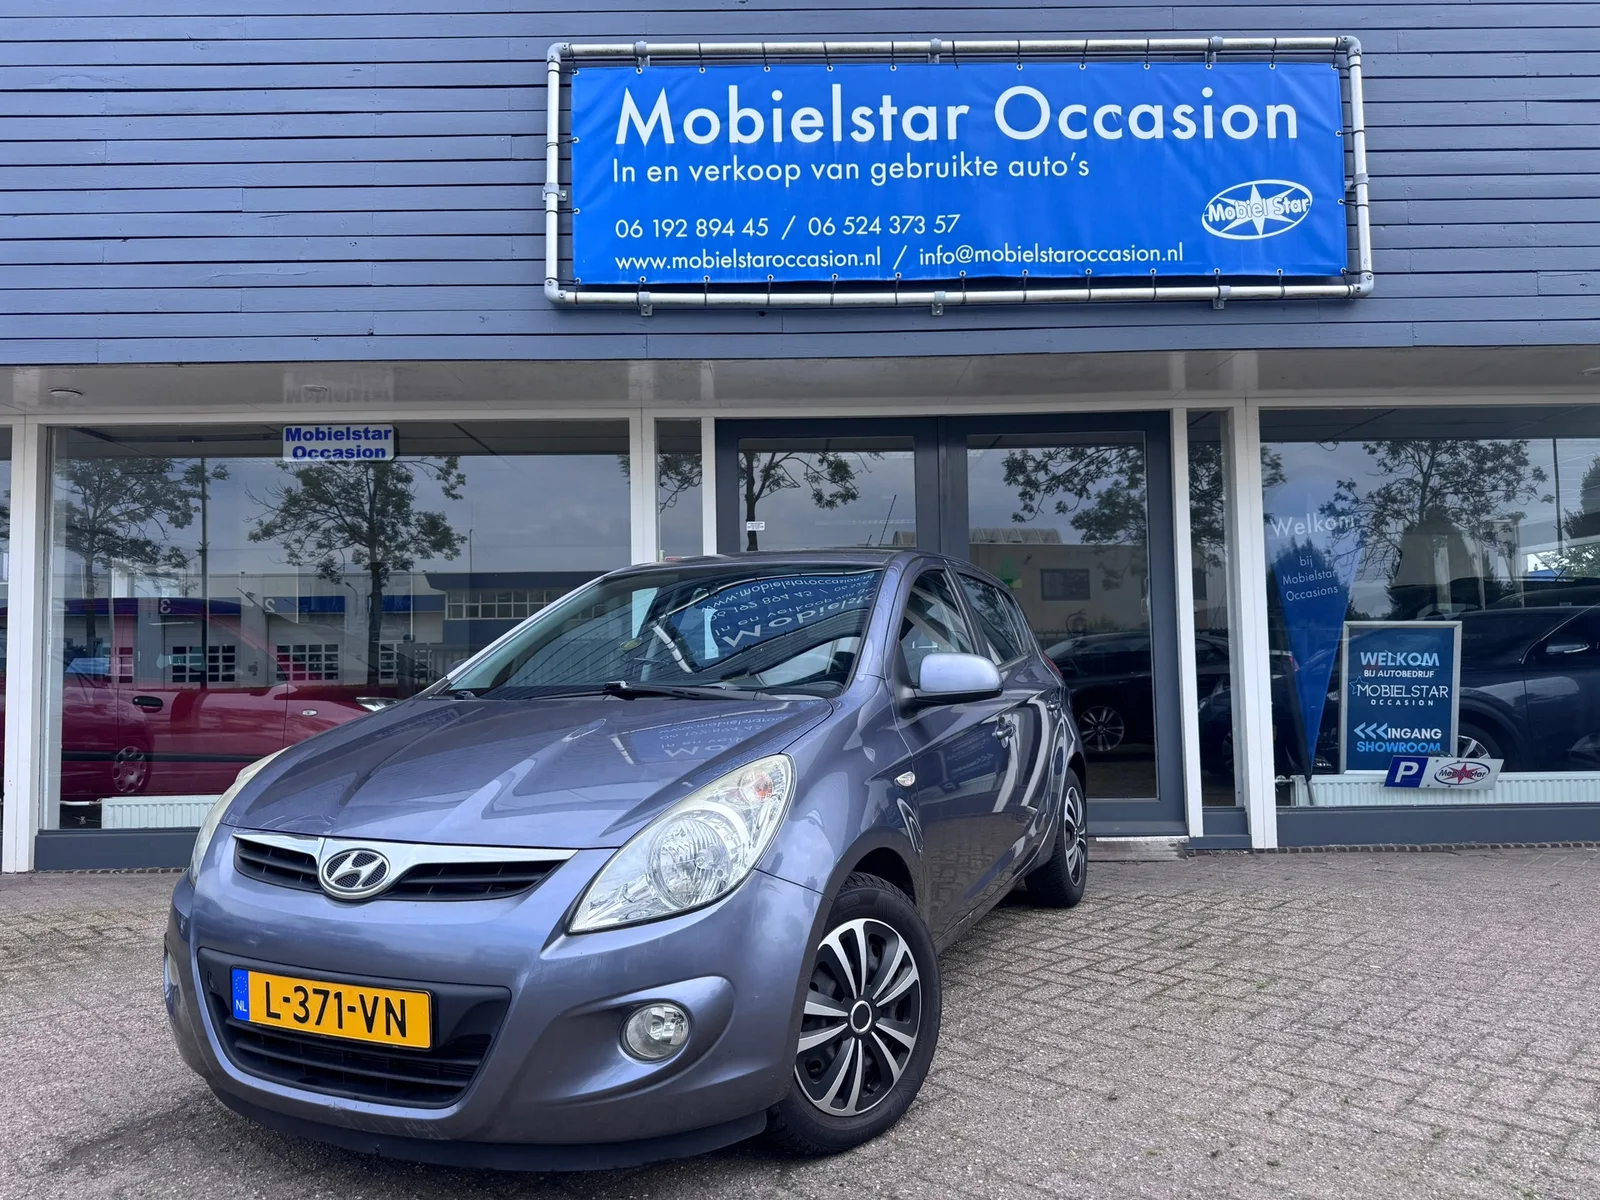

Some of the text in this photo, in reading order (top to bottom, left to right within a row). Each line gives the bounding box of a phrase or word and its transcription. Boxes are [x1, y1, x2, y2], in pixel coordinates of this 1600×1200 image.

[615, 83, 1298, 146] Mobielstar Occasion
[613, 151, 1090, 188] In en verkoop van gebruikte auto's
[1207, 196, 1309, 222] Mobiel Star
[615, 214, 961, 240] 06 192 894 45 / 06 524 373 57
[615, 241, 1183, 270] www.mobielstaroccasion.nl / info@mobielstaroccasion.nl
[285, 427, 392, 441] Mobielstar
[292, 445, 386, 459] Occasion
[1270, 512, 1355, 537] Welkom
[1299, 555, 1313, 568] bij
[1282, 569, 1337, 586] Mobielstar
[1286, 586, 1339, 601] Occasions
[1360, 652, 1440, 666] WELKOM
[1377, 670, 1435, 678] AUTOBEDRIJF
[1357, 684, 1449, 698] MOBIELSTAR
[1387, 728, 1442, 739] INGANG
[1356, 741, 1440, 753] SHOWROOM
[1394, 761, 1420, 783] P
[235, 981, 407, 1038] NL L-371-VN
